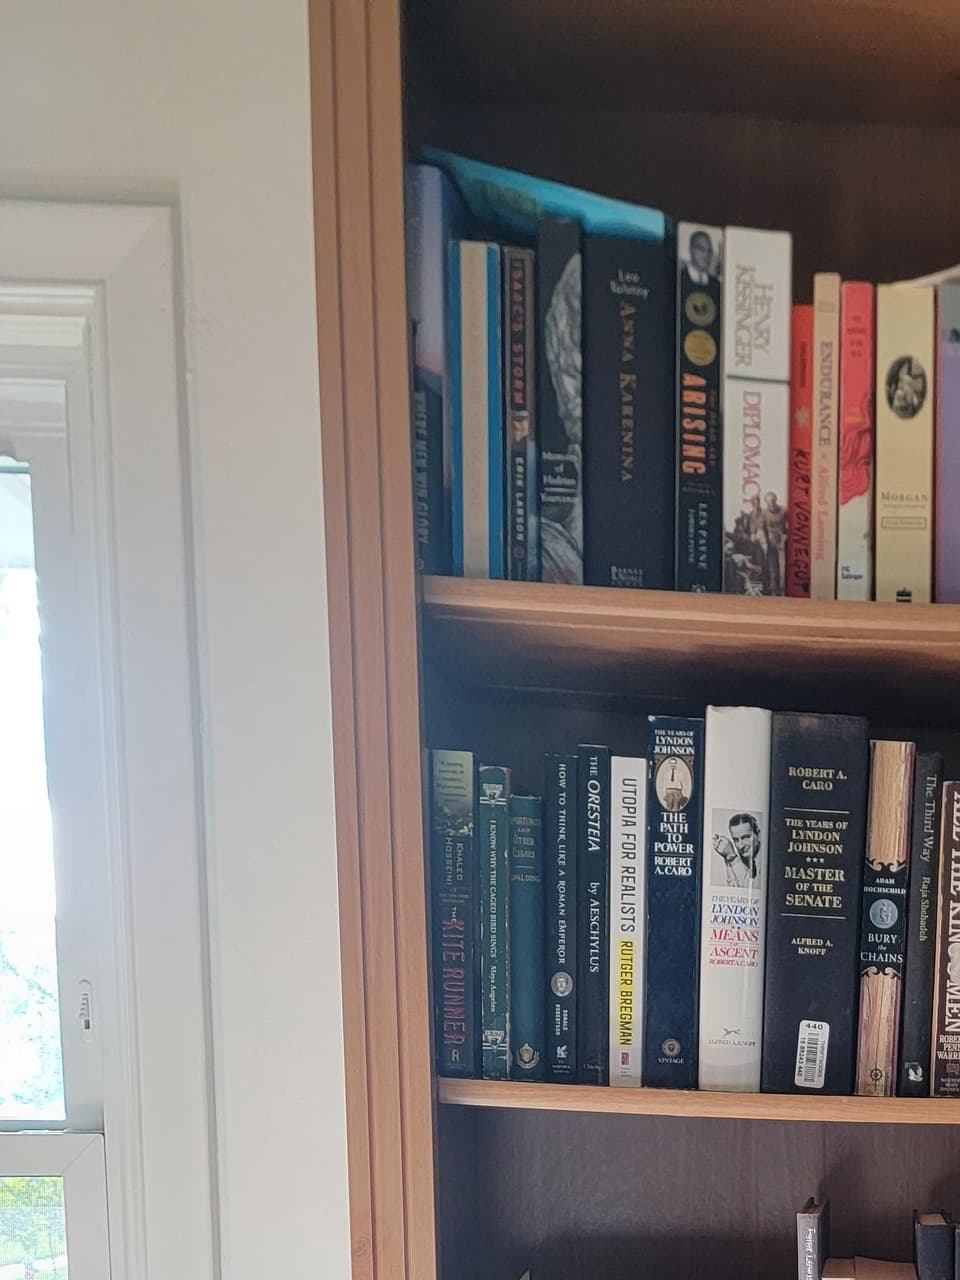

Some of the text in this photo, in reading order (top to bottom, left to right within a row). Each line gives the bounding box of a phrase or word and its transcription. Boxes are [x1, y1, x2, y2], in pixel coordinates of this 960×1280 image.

[733, 263, 753, 367] KISSINGER
[752, 283, 774, 355] HENRY
[511, 343, 526, 404] STORM
[618, 302, 639, 483] ANNA KARENINA
[817, 340, 834, 447] ENDURANCE
[681, 372, 708, 475] ARISING
[740, 390, 763, 511] DIPLOMACY
[514, 456, 526, 541] ERIK LARSON
[881, 491, 928, 502] MORGAN
[793, 447, 812, 592] KURT VONNEGUT
[558, 762, 567, 787] HOW
[558, 792, 567, 805] TO
[558, 809, 567, 841] THINK
[659, 823, 688, 834] PATH
[660, 812, 687, 824] THE
[557, 844, 567, 866] LIKE
[654, 842, 694, 854] POWER
[666, 833, 682, 843] TO
[586, 755, 602, 974] THE ORESTEIA by AESCHYLUS
[784, 867, 845, 882] MASTER
[557, 880, 567, 916] ROMAN
[785, 894, 842, 909] SENATE
[796, 882, 834, 893] OF THE
[619, 777, 638, 1047] UTOPIA FOR REALISTS RUTGER BREGMAN
[557, 919, 567, 965] EMPEROR
[868, 932, 898, 944] BURY
[860, 952, 904, 963] CHAINS
[442, 919, 466, 1045] KITE RUNNER
